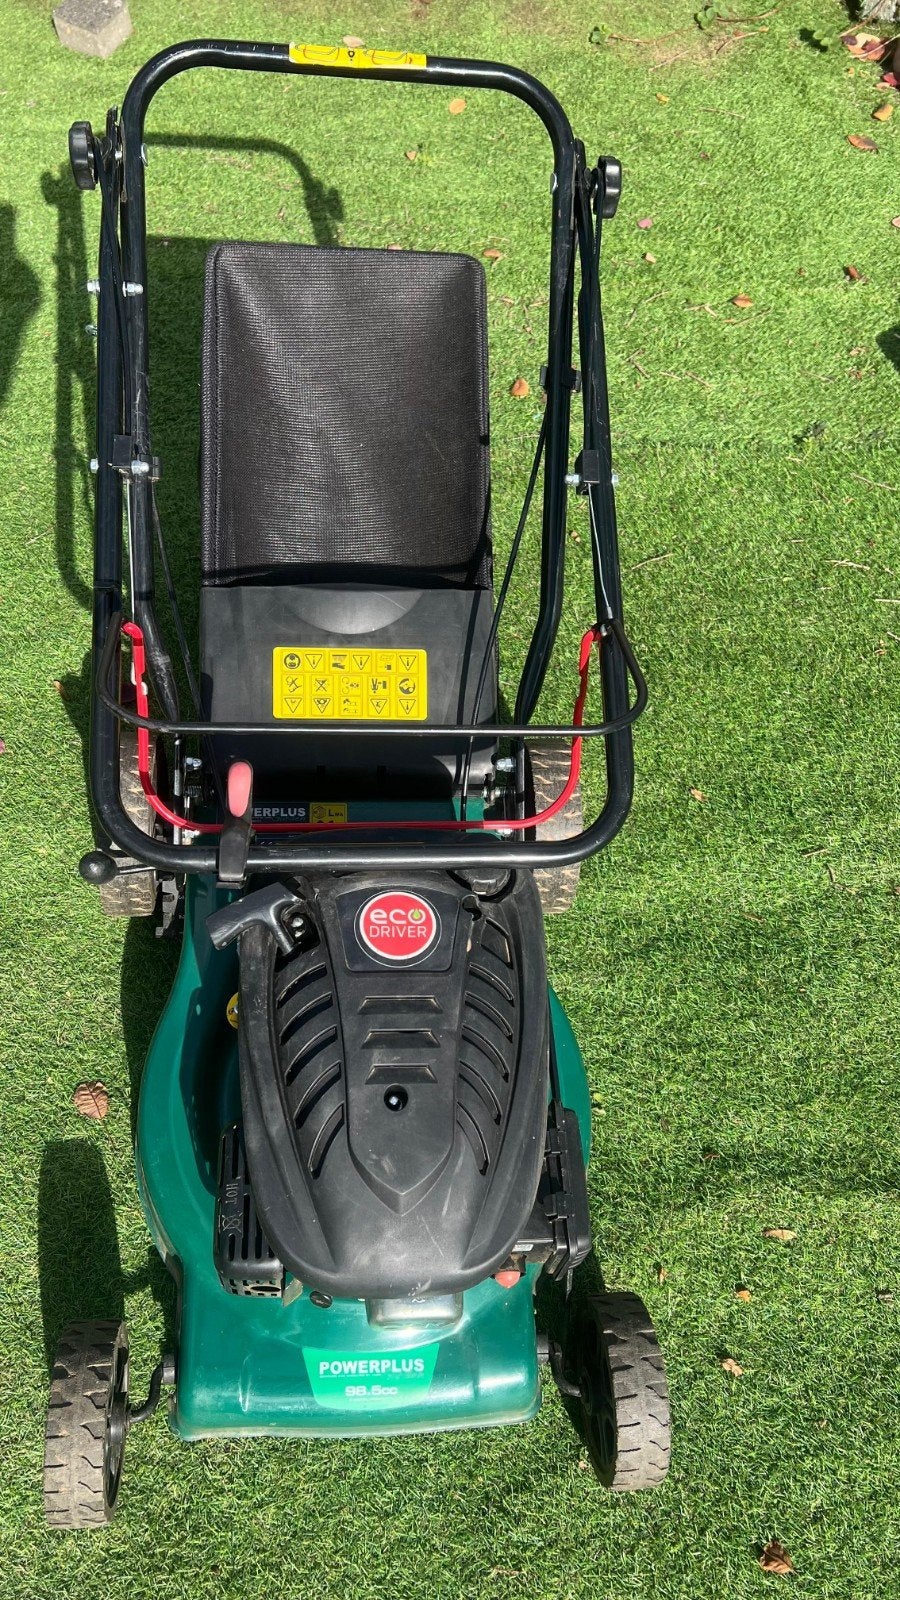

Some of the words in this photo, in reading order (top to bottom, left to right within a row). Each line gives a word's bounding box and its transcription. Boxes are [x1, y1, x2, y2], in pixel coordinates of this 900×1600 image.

[250, 807, 306, 817] ERPLUS
[369, 908, 426, 925] eco
[369, 926, 427, 938] DRIVER
[225, 1183, 239, 1205] HOT
[319, 1358, 425, 1375] POWERPLUS
[344, 1385, 398, 1397] 98.5cc
